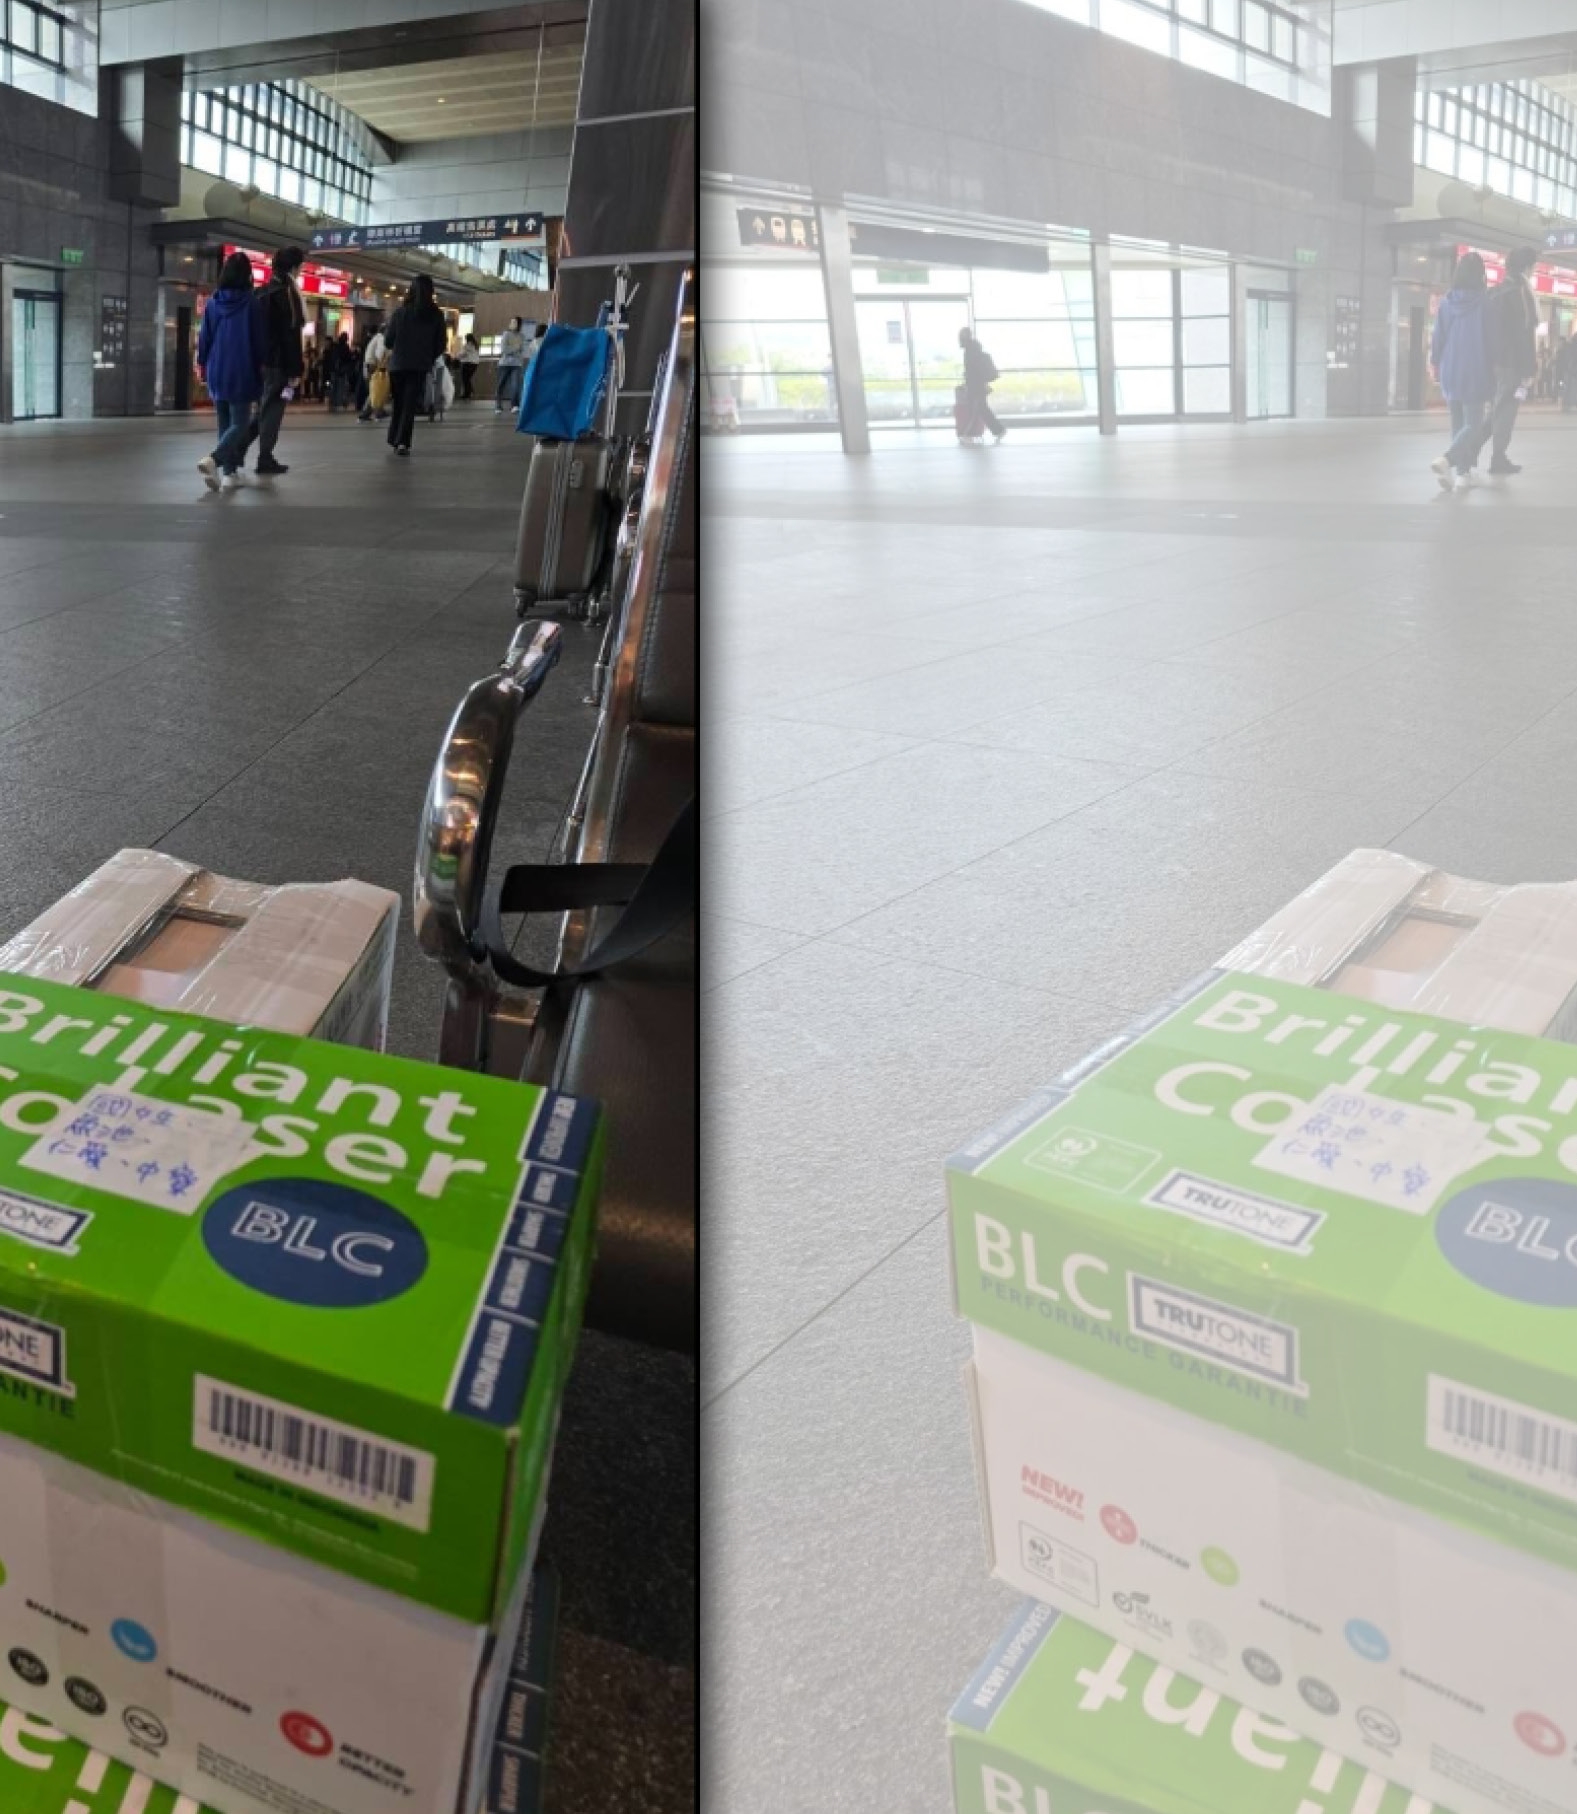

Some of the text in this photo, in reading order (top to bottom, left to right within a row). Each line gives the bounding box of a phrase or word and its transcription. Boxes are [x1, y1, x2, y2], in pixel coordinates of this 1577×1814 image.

[231, 1200, 395, 1279] BLC
[974, 1211, 1112, 1322] BLC
[1464, 1200, 1577, 1263] BL
